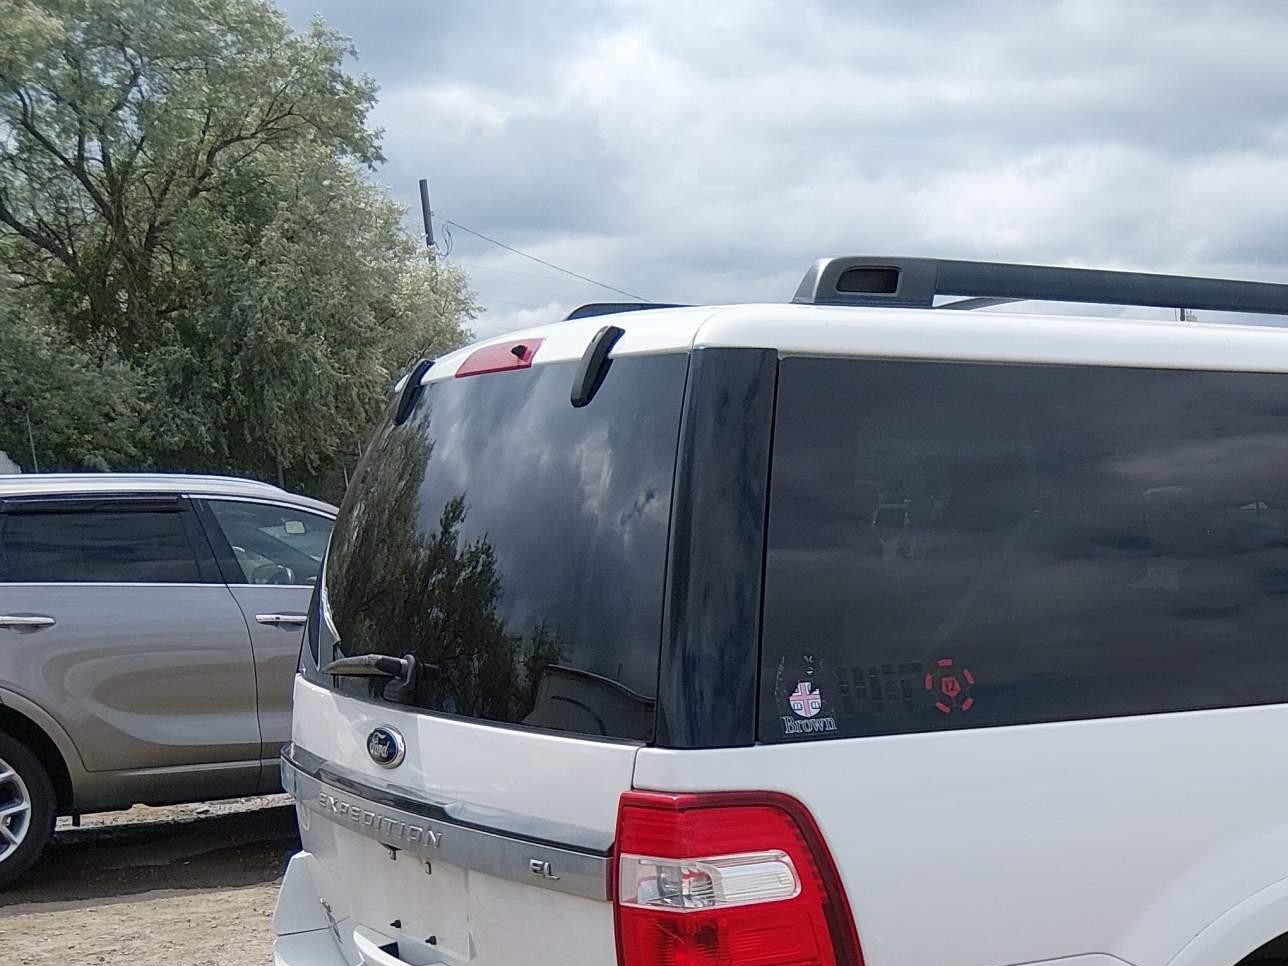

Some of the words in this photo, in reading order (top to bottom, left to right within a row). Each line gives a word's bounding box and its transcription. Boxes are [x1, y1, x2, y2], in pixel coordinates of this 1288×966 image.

[780, 716, 838, 734] Brown
[370, 731, 391, 759] Ford
[319, 792, 443, 849] EXPEDITION
[529, 859, 561, 880] EL
